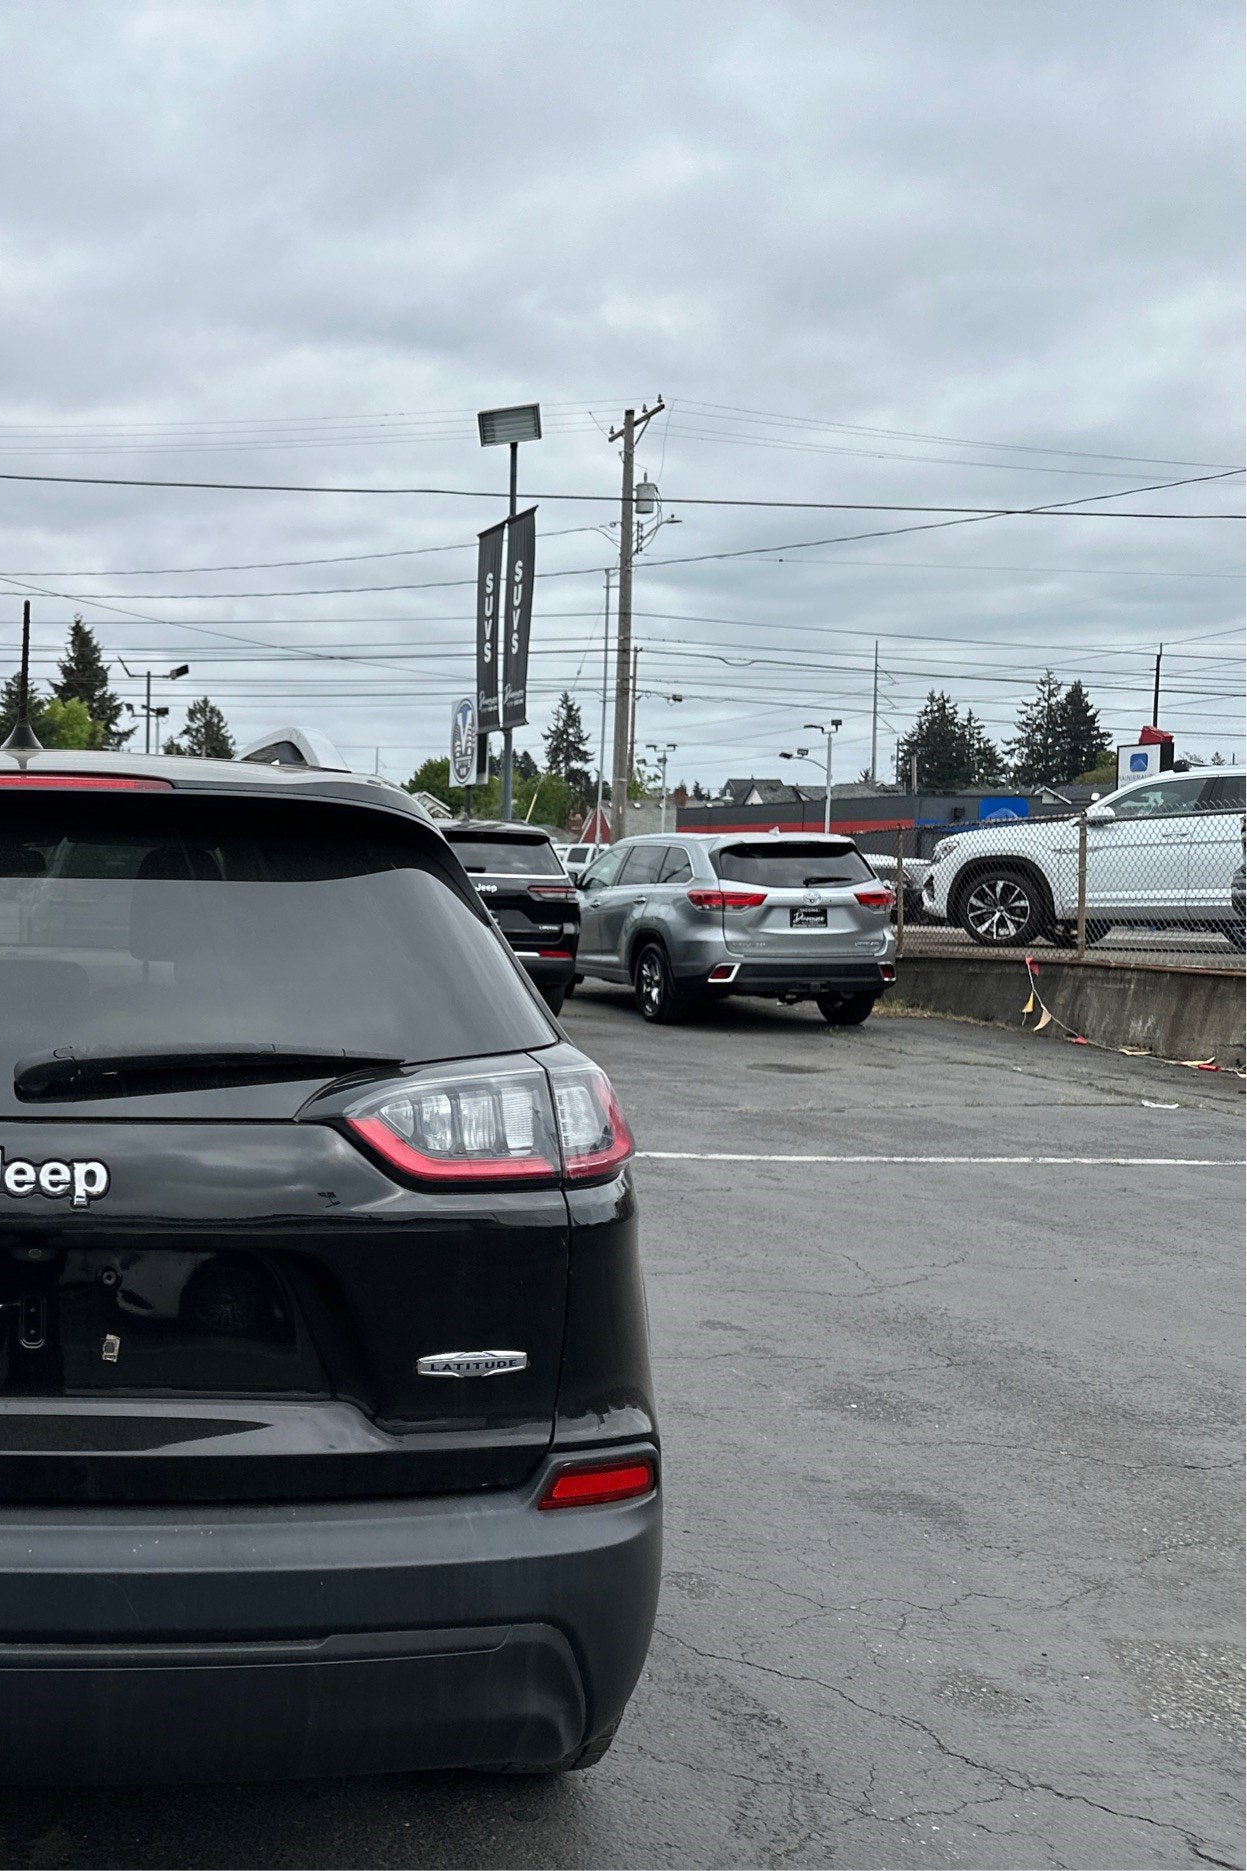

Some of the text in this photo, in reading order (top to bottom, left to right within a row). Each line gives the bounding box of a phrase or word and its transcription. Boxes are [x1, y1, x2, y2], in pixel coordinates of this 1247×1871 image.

[484, 572, 494, 663] SUVS
[512, 560, 523, 655] SUVS
[475, 883, 498, 893] Jeep
[430, 1359, 518, 1372] LATITUDE
